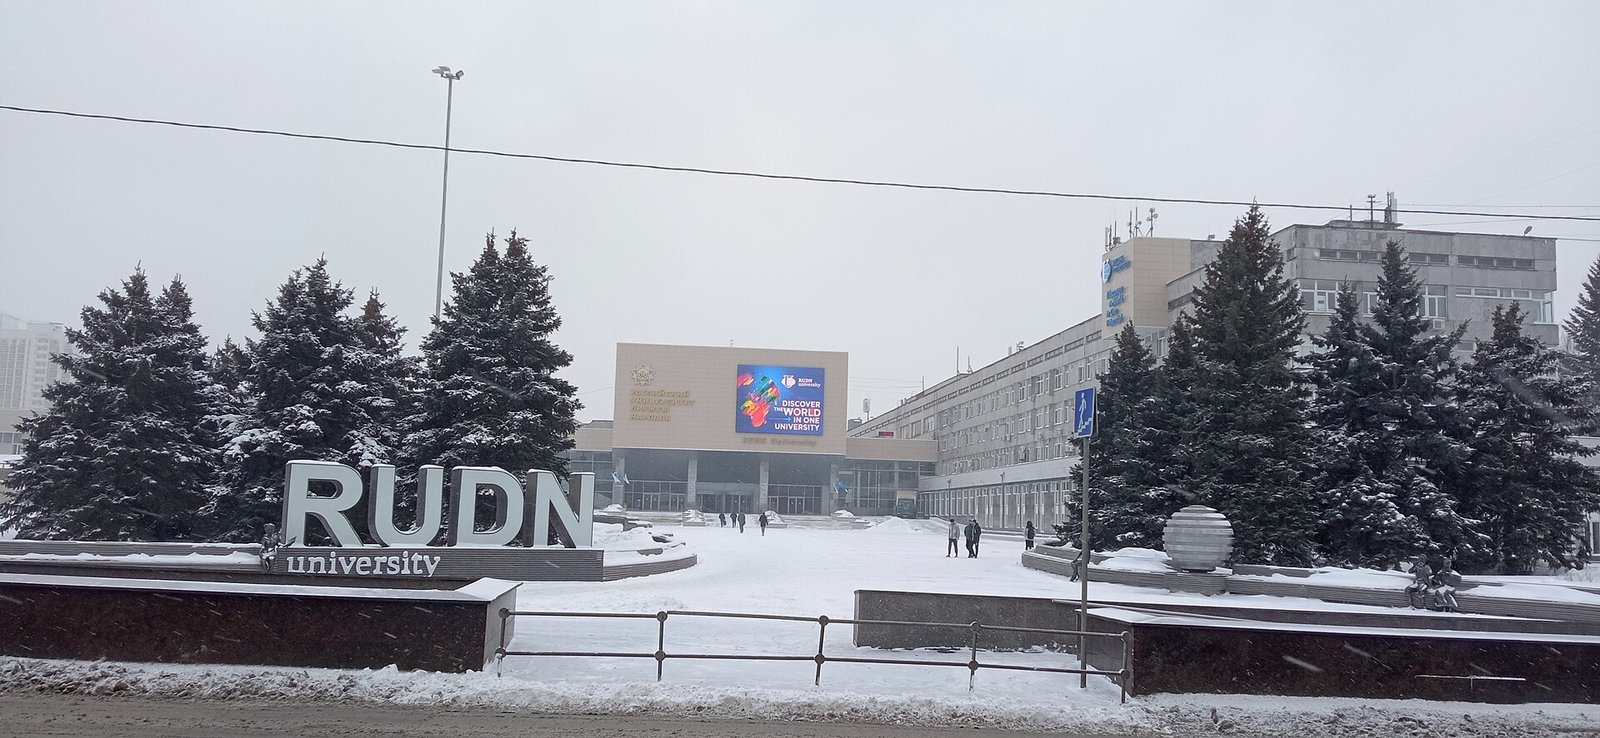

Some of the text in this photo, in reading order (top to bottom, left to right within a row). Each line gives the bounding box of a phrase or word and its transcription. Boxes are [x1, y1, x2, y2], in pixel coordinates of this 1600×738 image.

[782, 400, 821, 408] DISCOVER
[783, 407, 821, 417] WORLD
[803, 416, 820, 424] ONE
[774, 422, 820, 431] UNIVERSITY
[283, 460, 596, 548] RUDN
[287, 551, 441, 578] university
